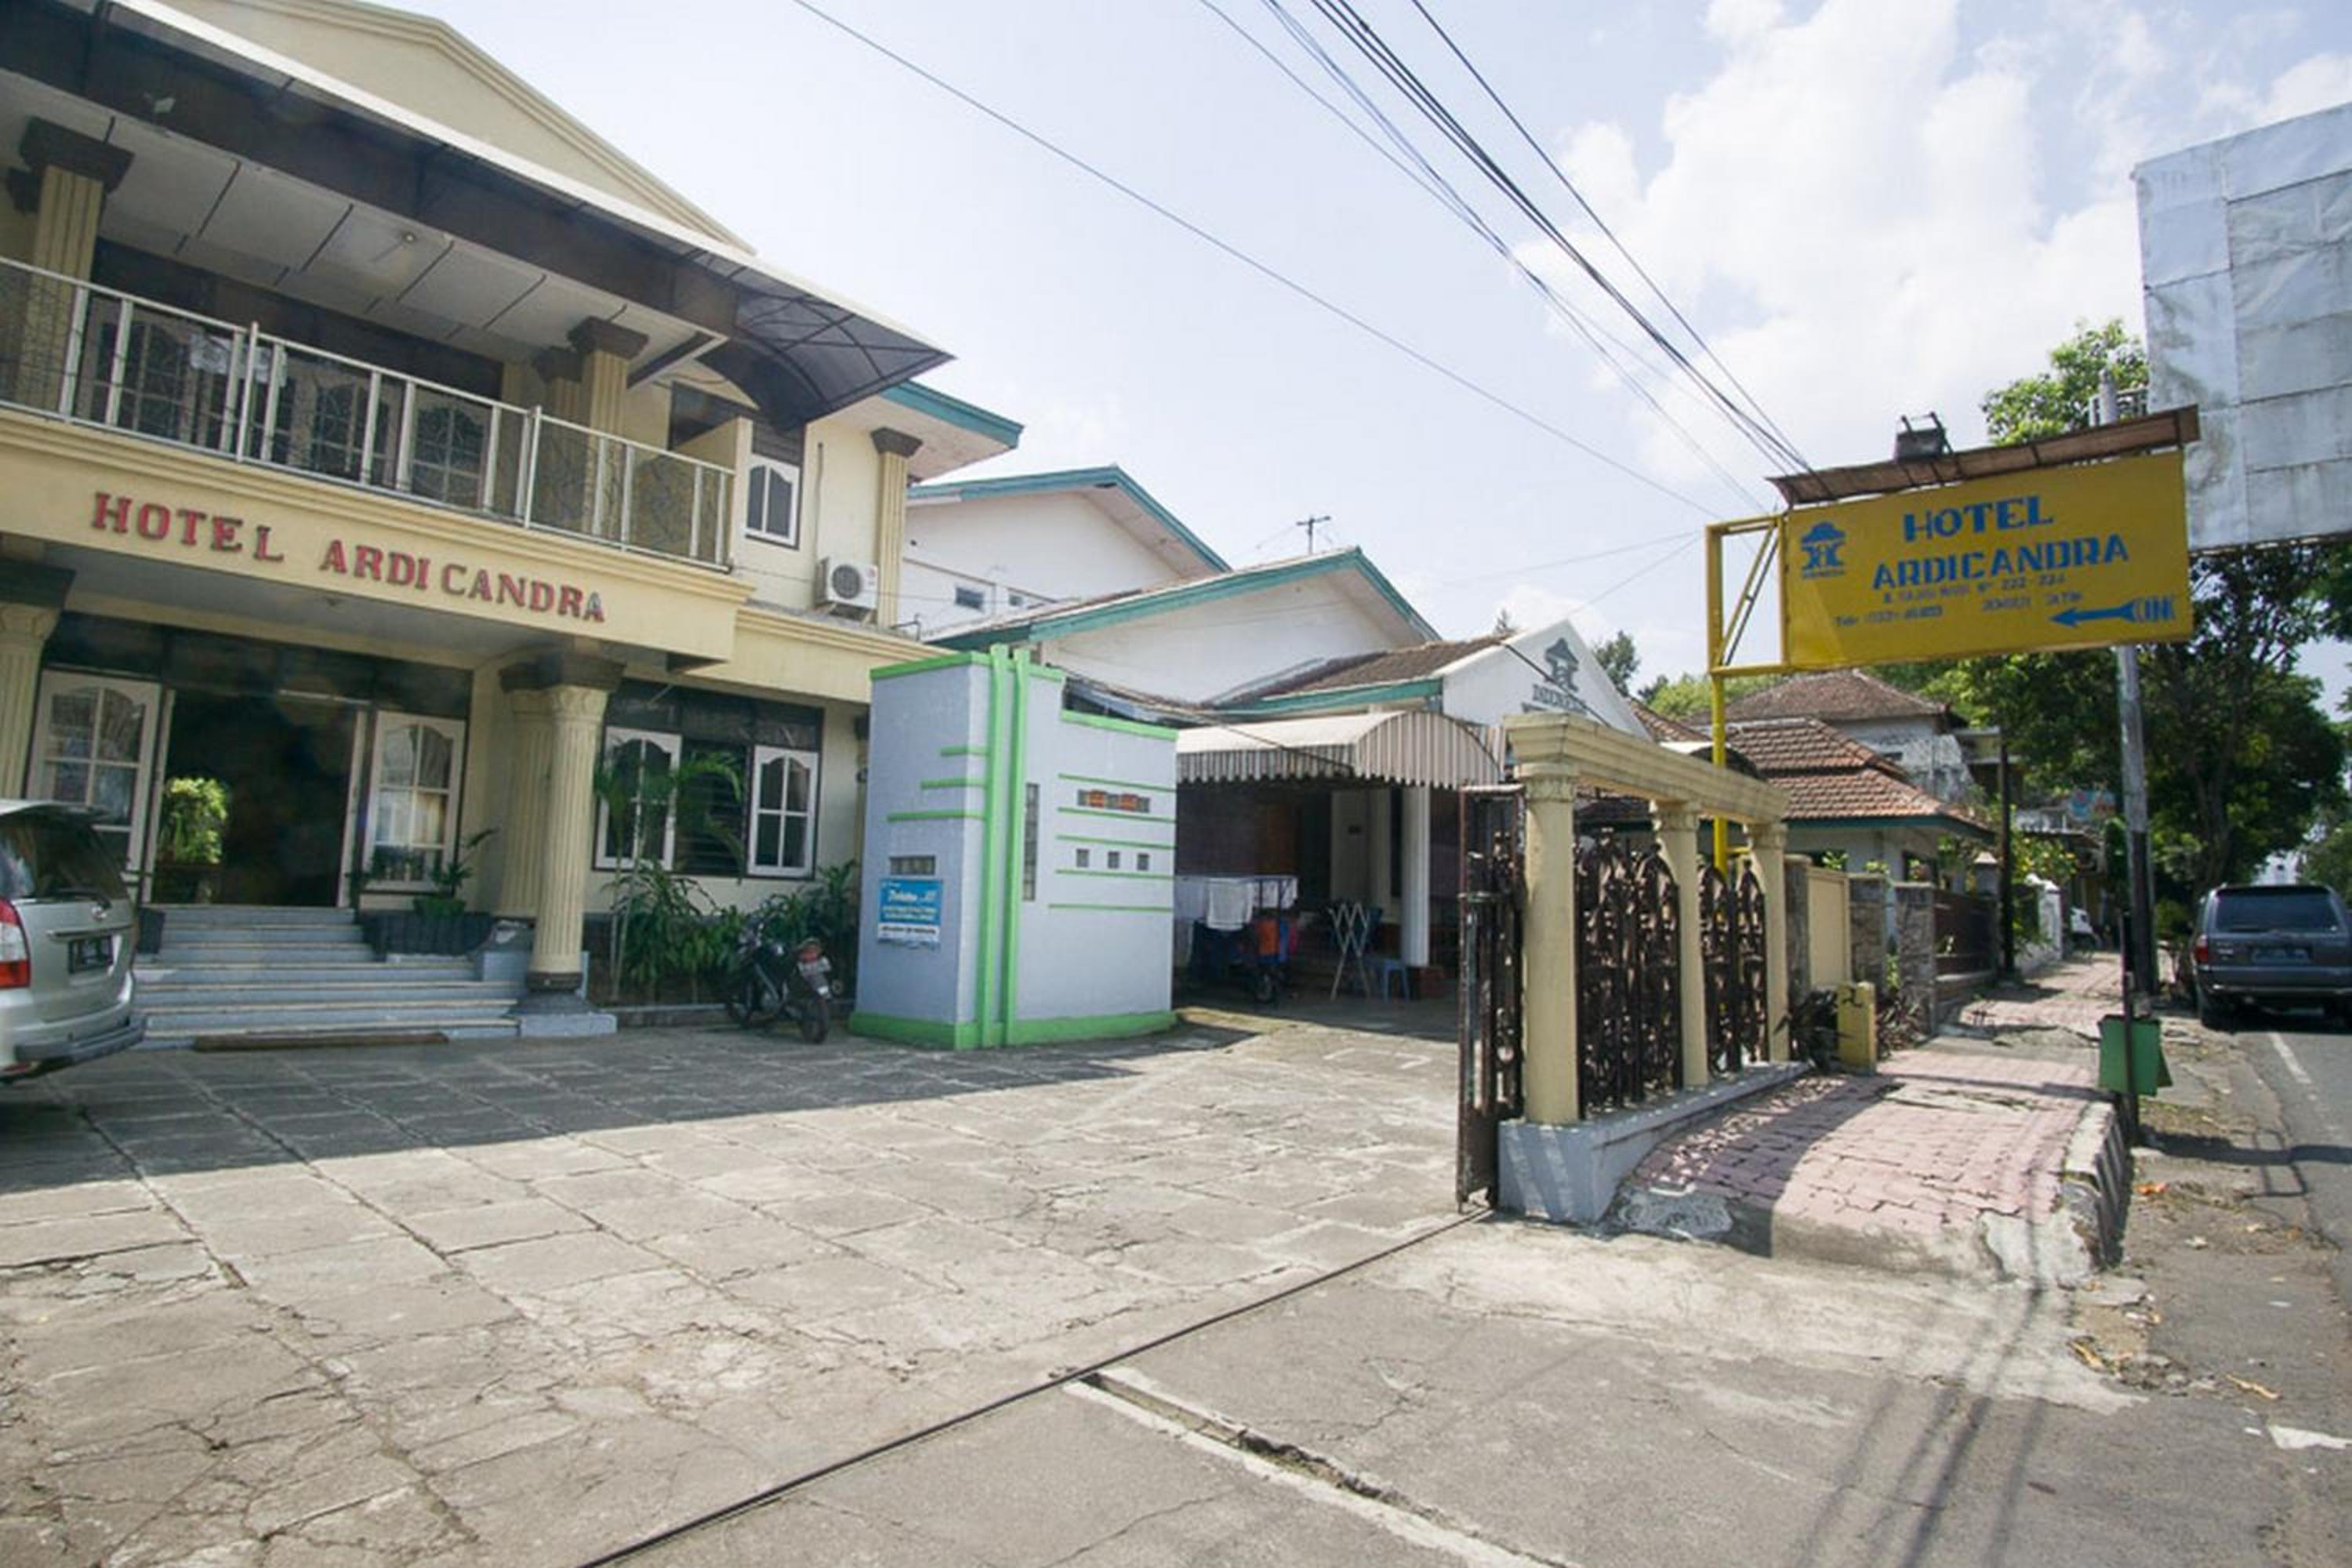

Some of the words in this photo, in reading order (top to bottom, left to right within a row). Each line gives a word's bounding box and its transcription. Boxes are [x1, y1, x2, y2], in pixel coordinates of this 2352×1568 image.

[92, 492, 283, 563] HOTEL
[1903, 495, 2054, 543] HOTEL
[1873, 533, 2129, 590] ARDICANDRA
